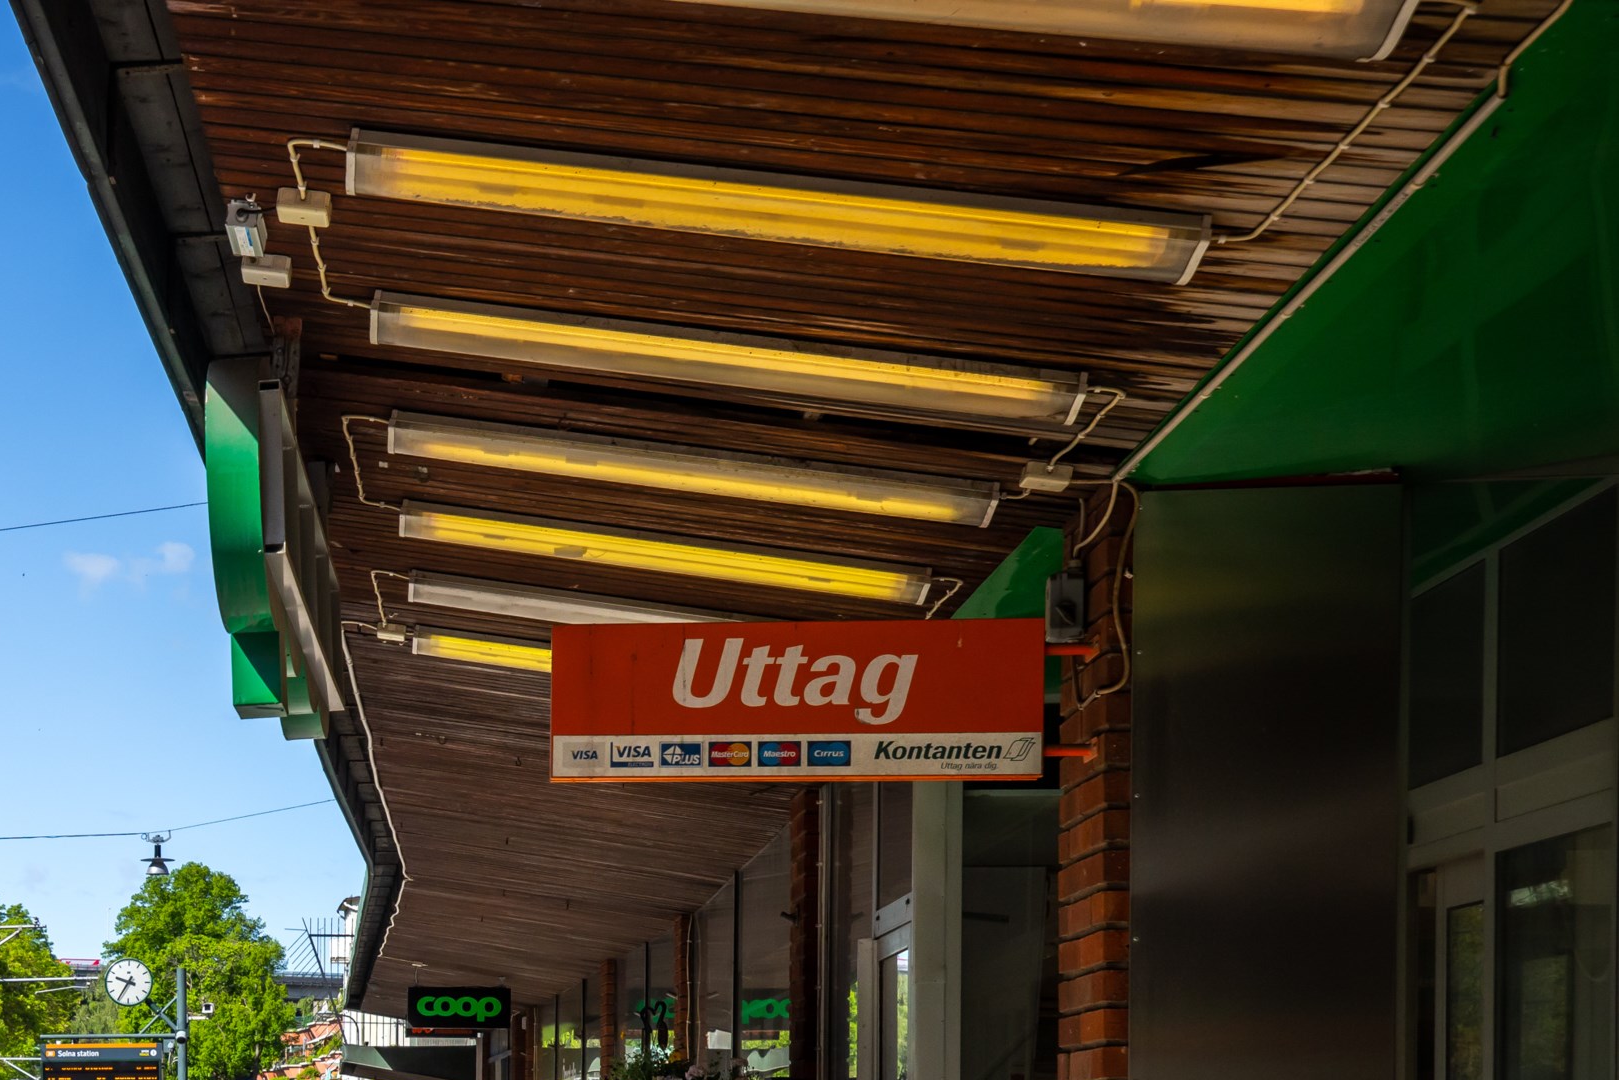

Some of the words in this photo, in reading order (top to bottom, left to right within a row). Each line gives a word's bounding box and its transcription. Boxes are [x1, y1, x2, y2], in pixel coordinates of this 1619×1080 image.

[672, 637, 919, 726] Uttag
[571, 750, 598, 760] VISA
[615, 745, 652, 758] VISA
[710, 750, 749, 759] MasterCard
[762, 750, 796, 758] Maestro
[813, 749, 845, 758] Cirrus
[874, 741, 1002, 760] Kontanten
[672, 754, 700, 765] PLUS
[940, 761, 963, 771] Uttag
[964, 761, 983, 770] nära
[416, 996, 502, 1022] coop
